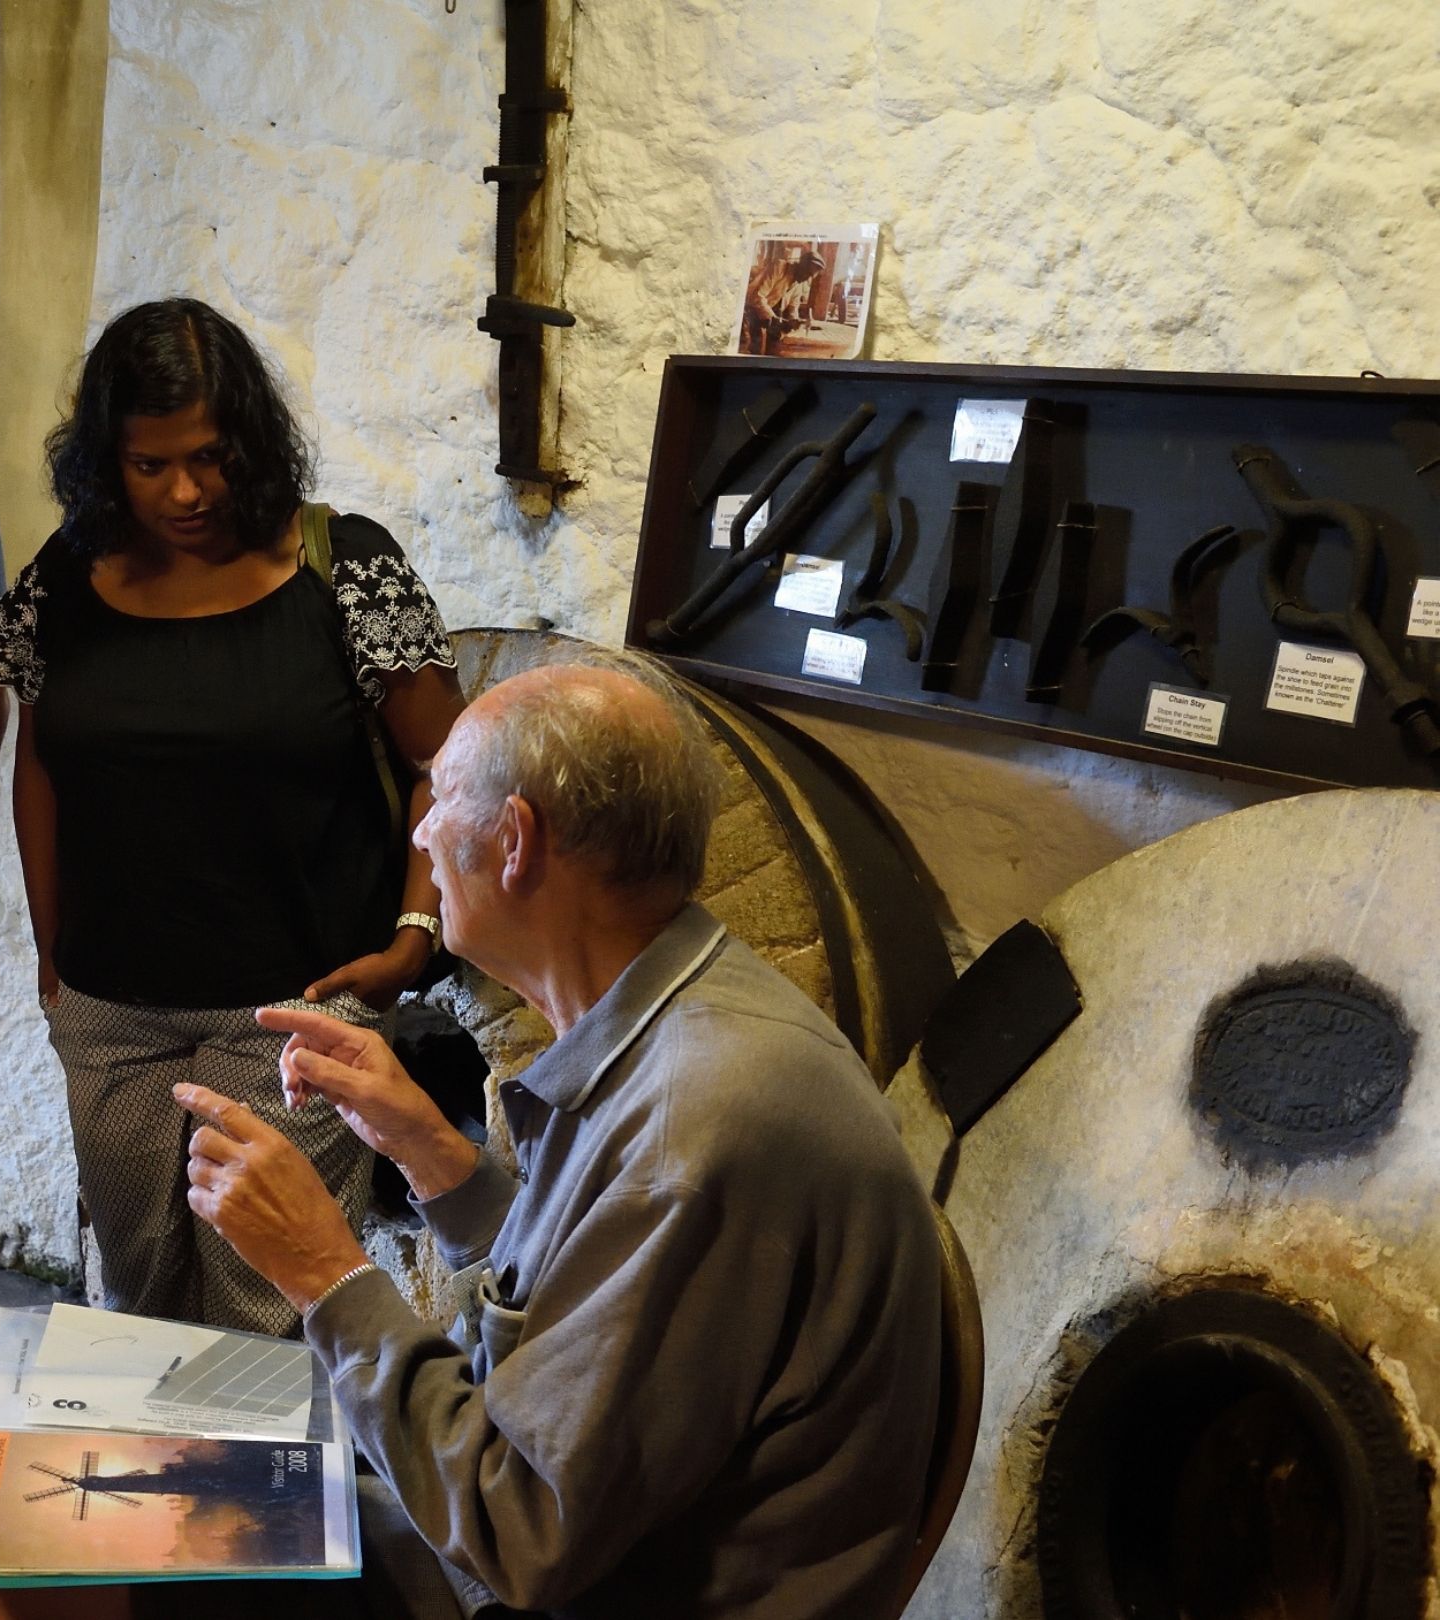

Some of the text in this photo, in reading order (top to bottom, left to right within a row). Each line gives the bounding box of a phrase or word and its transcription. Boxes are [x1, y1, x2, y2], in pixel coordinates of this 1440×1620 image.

[1305, 652, 1334, 663] Damsel
[1168, 695, 1206, 709] Chain Stay
[270, 1449, 285, 1488] Visitor Guide
[288, 1450, 307, 1473] 2008
